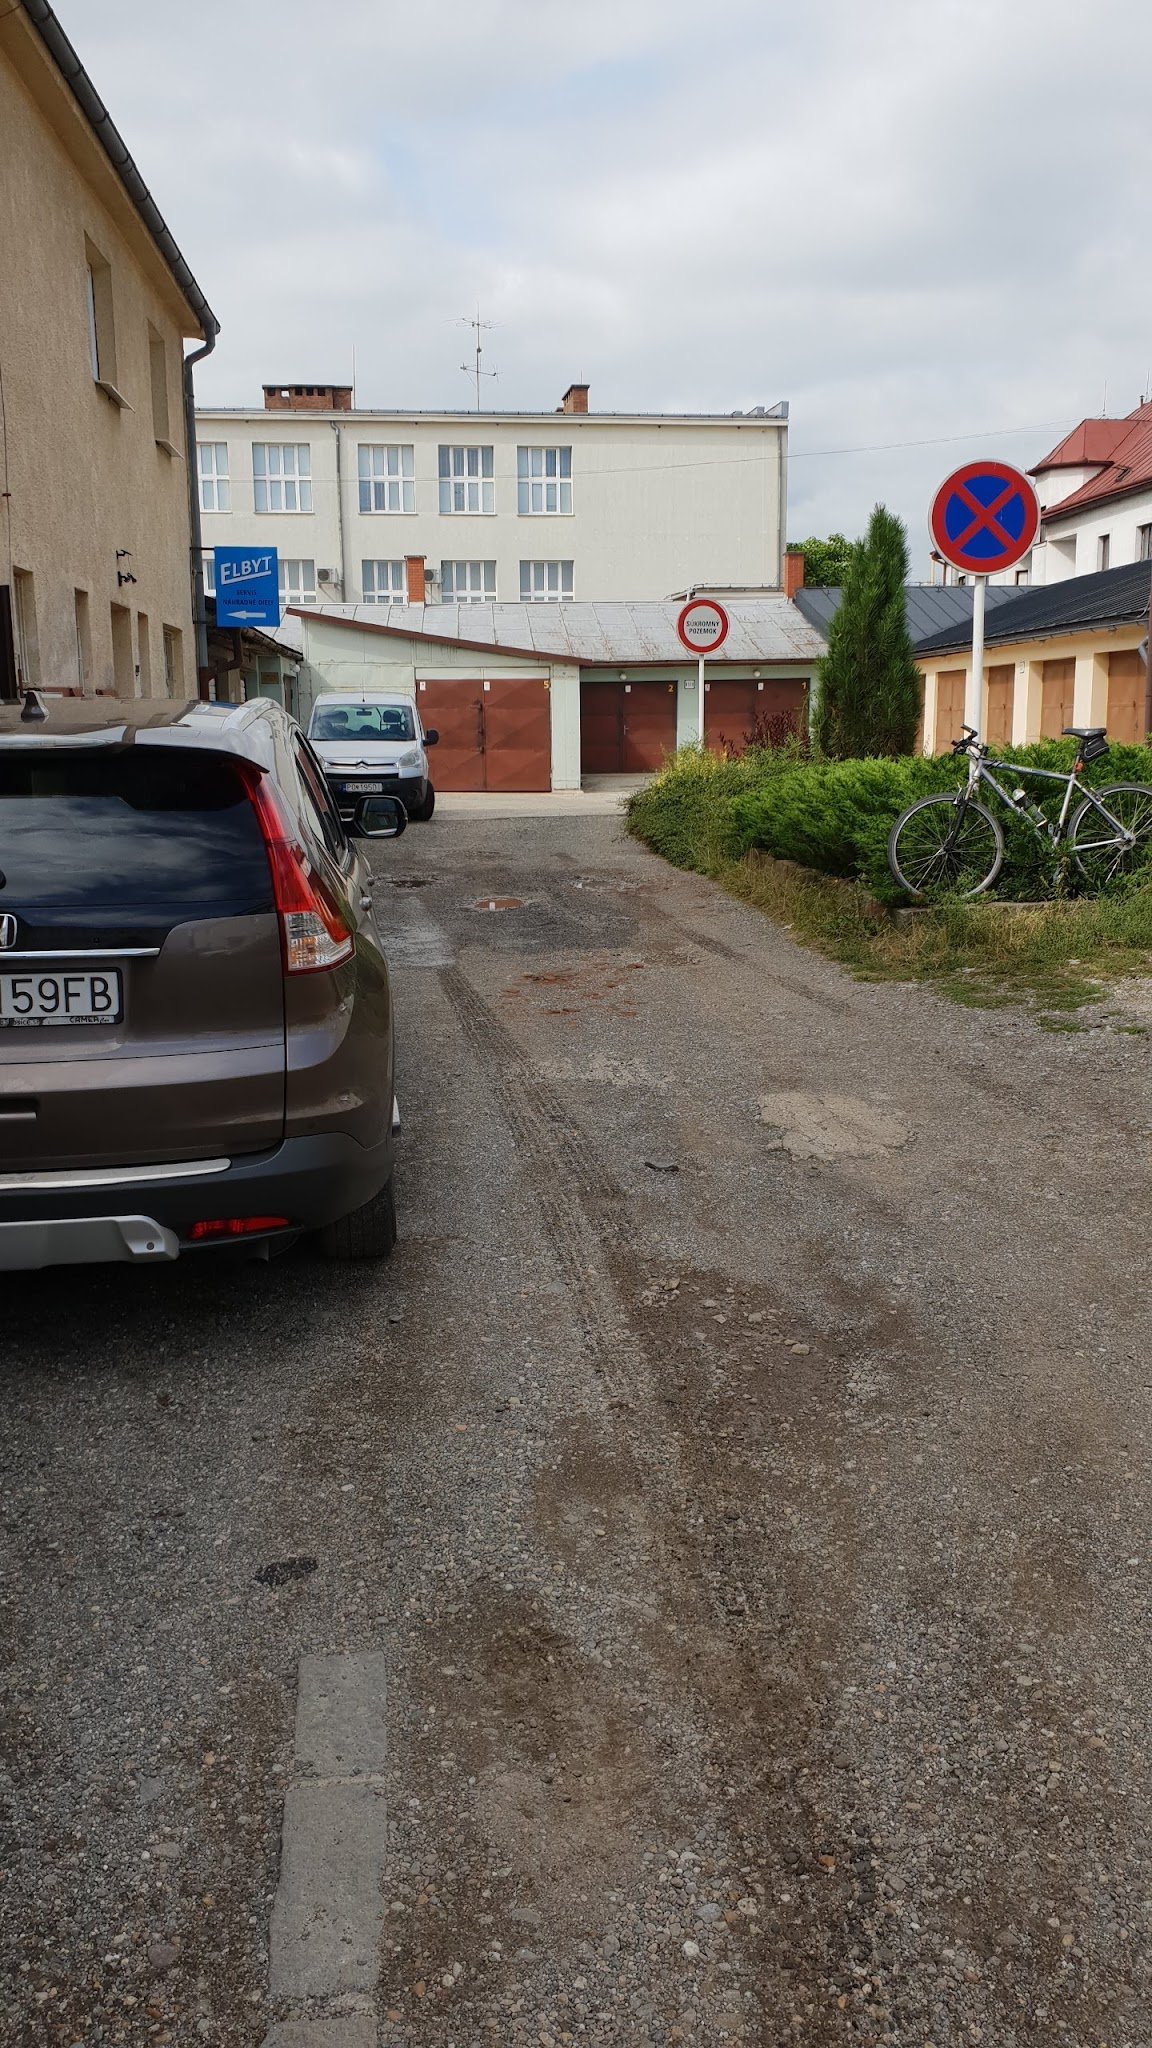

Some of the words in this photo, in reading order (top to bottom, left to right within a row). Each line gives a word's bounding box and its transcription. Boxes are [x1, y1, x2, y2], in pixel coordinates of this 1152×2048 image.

[221, 556, 272, 584] ELBYT
[543, 680, 549, 689] 5
[668, 684, 674, 693] 2
